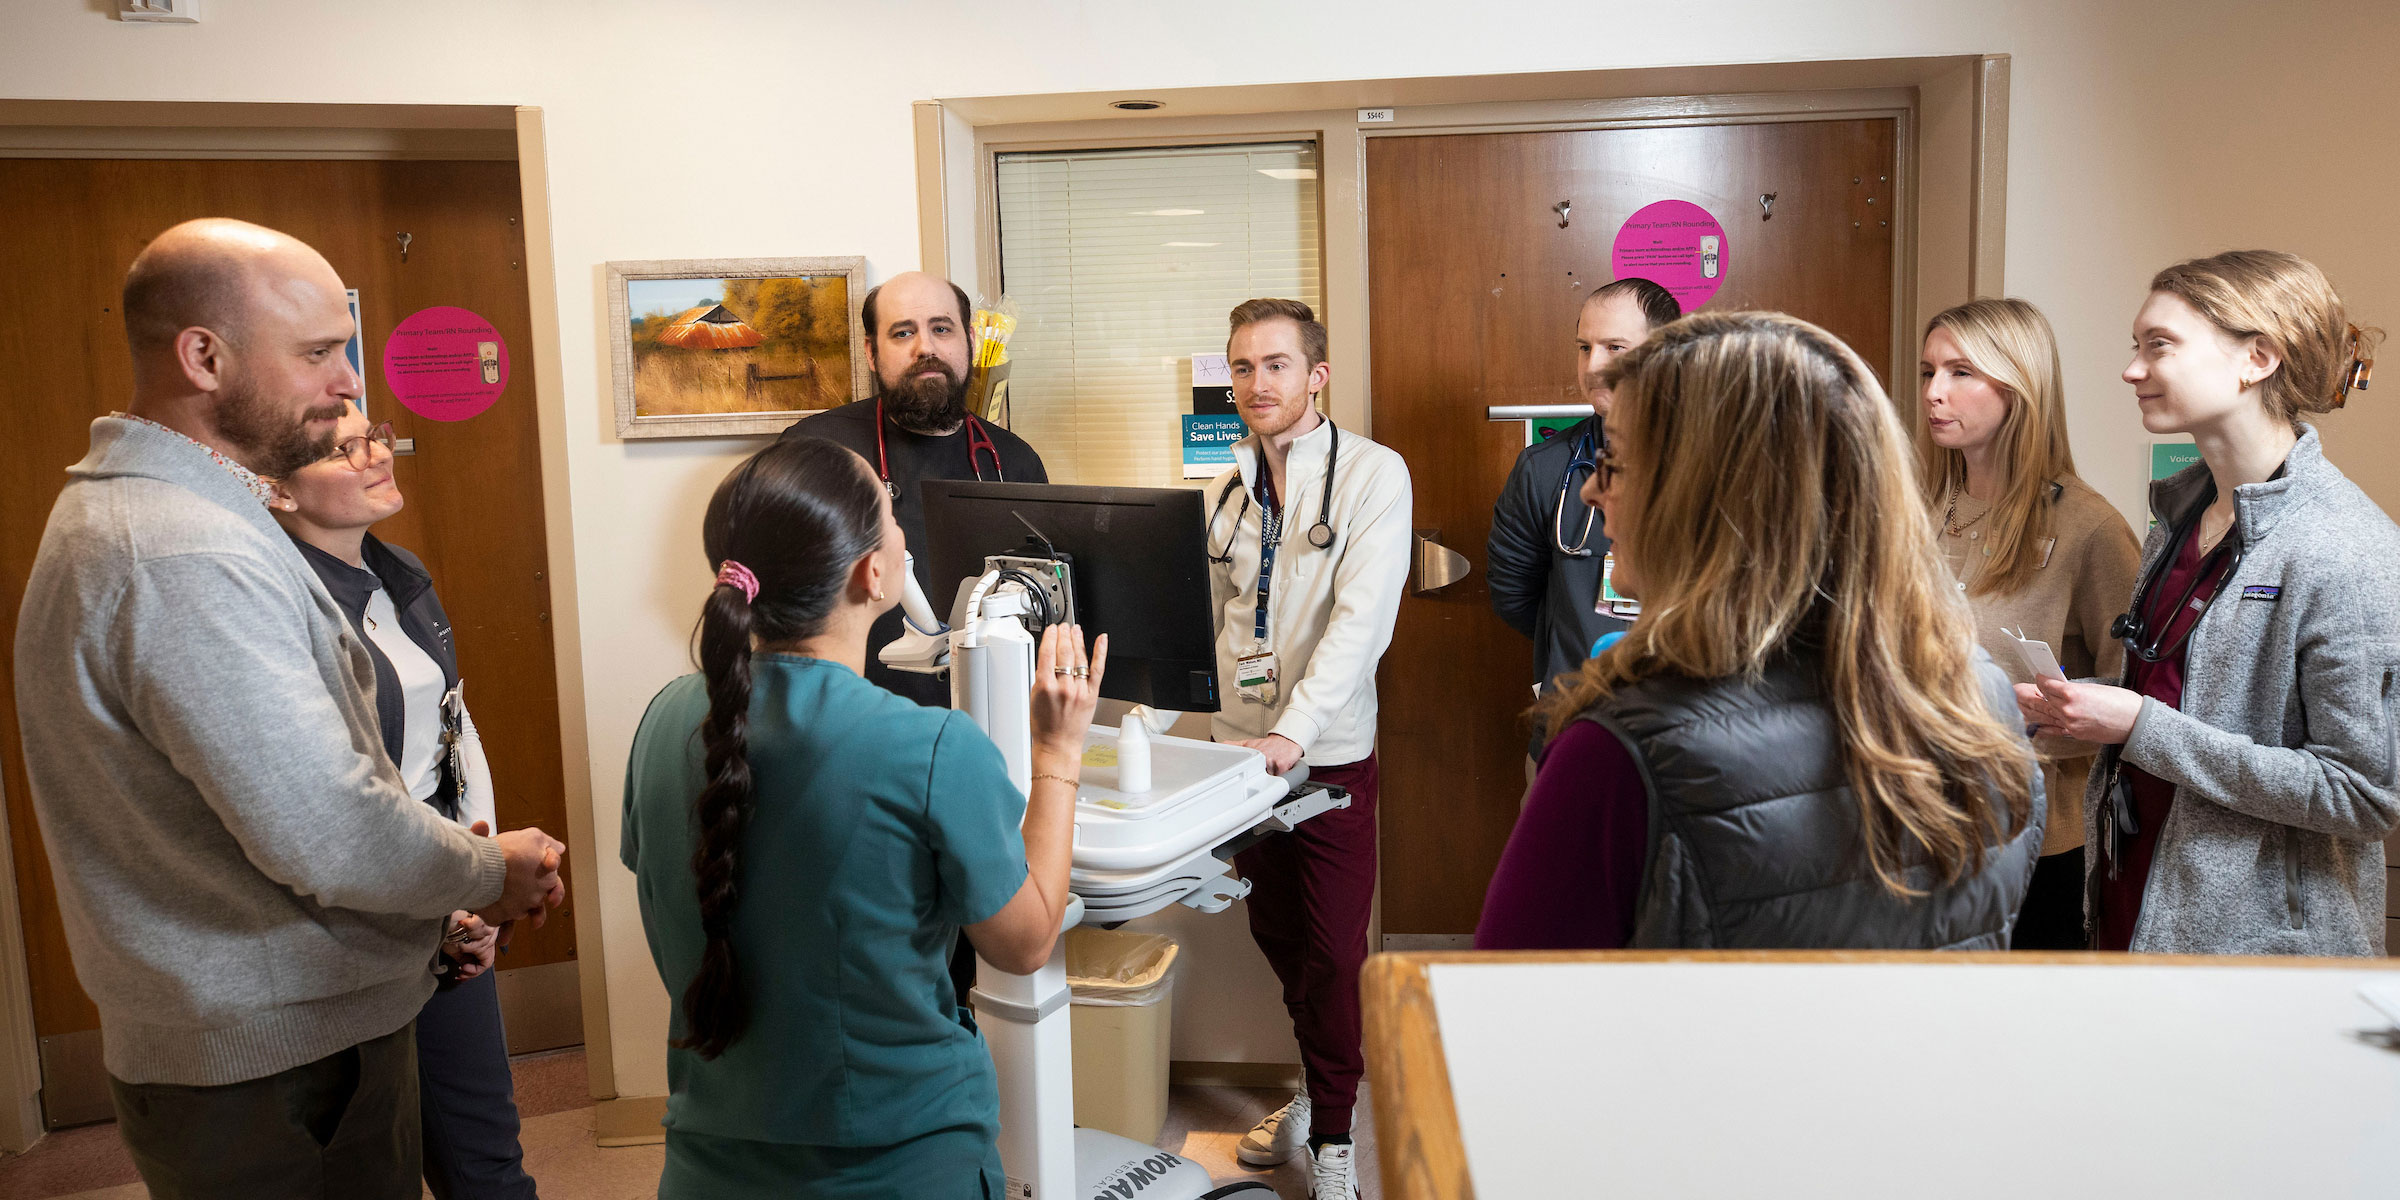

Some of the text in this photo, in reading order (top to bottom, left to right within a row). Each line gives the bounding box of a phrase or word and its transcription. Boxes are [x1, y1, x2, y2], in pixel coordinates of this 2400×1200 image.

[1626, 222, 1651, 230] Primary
[1682, 220, 1715, 228] Rounding
[1192, 421, 1240, 430] Clean Hands
[1190, 431, 1242, 442] Save Lives
[1093, 1160, 1136, 1189] MEDICAL
